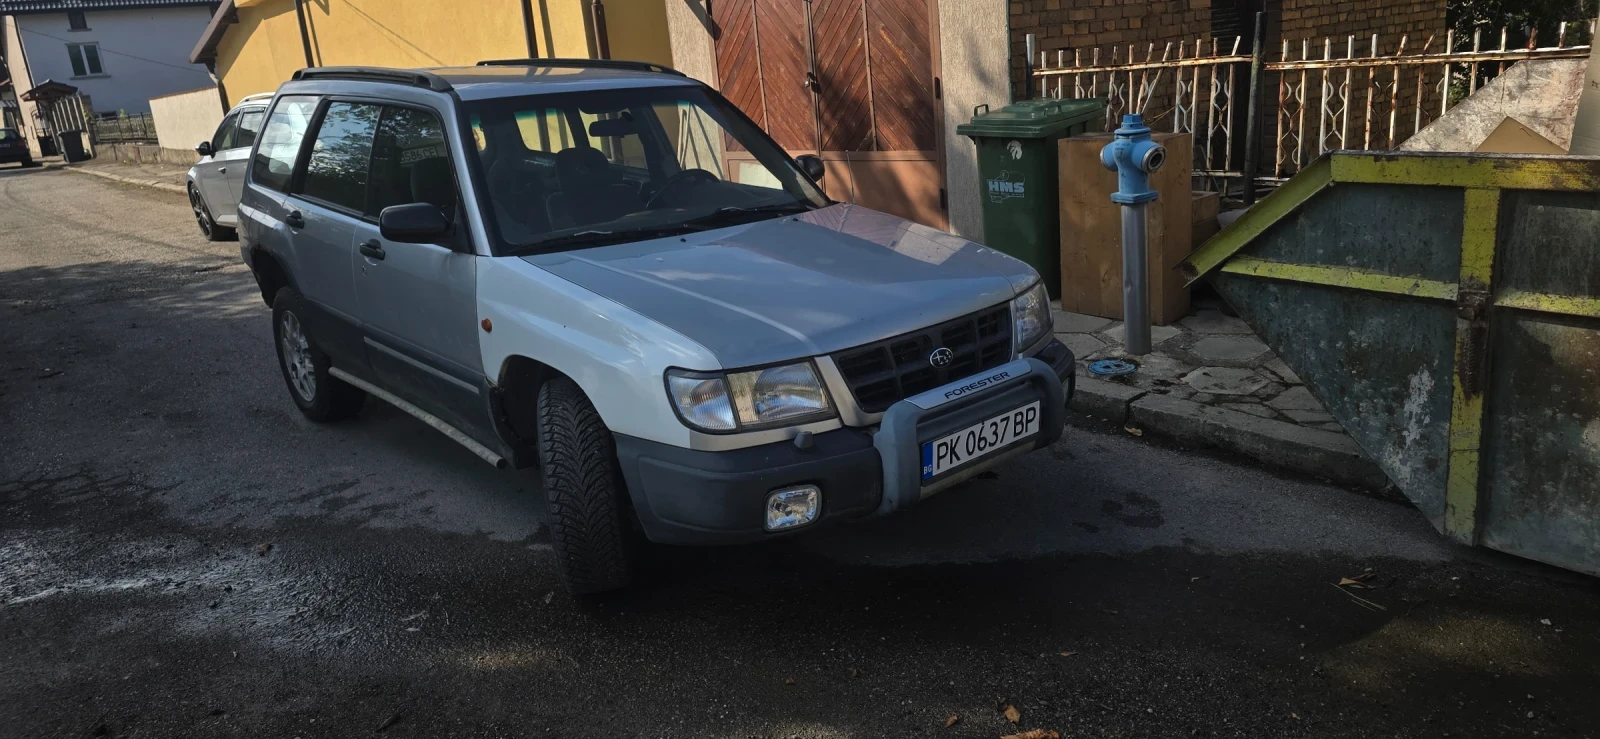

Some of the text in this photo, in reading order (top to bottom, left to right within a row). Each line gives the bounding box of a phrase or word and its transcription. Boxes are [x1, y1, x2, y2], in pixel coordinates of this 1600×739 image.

[989, 181, 1024, 193] HMS
[944, 371, 1011, 399] FORESTER
[936, 406, 1037, 470] PK 0637 BP
[923, 464, 933, 475] BG
